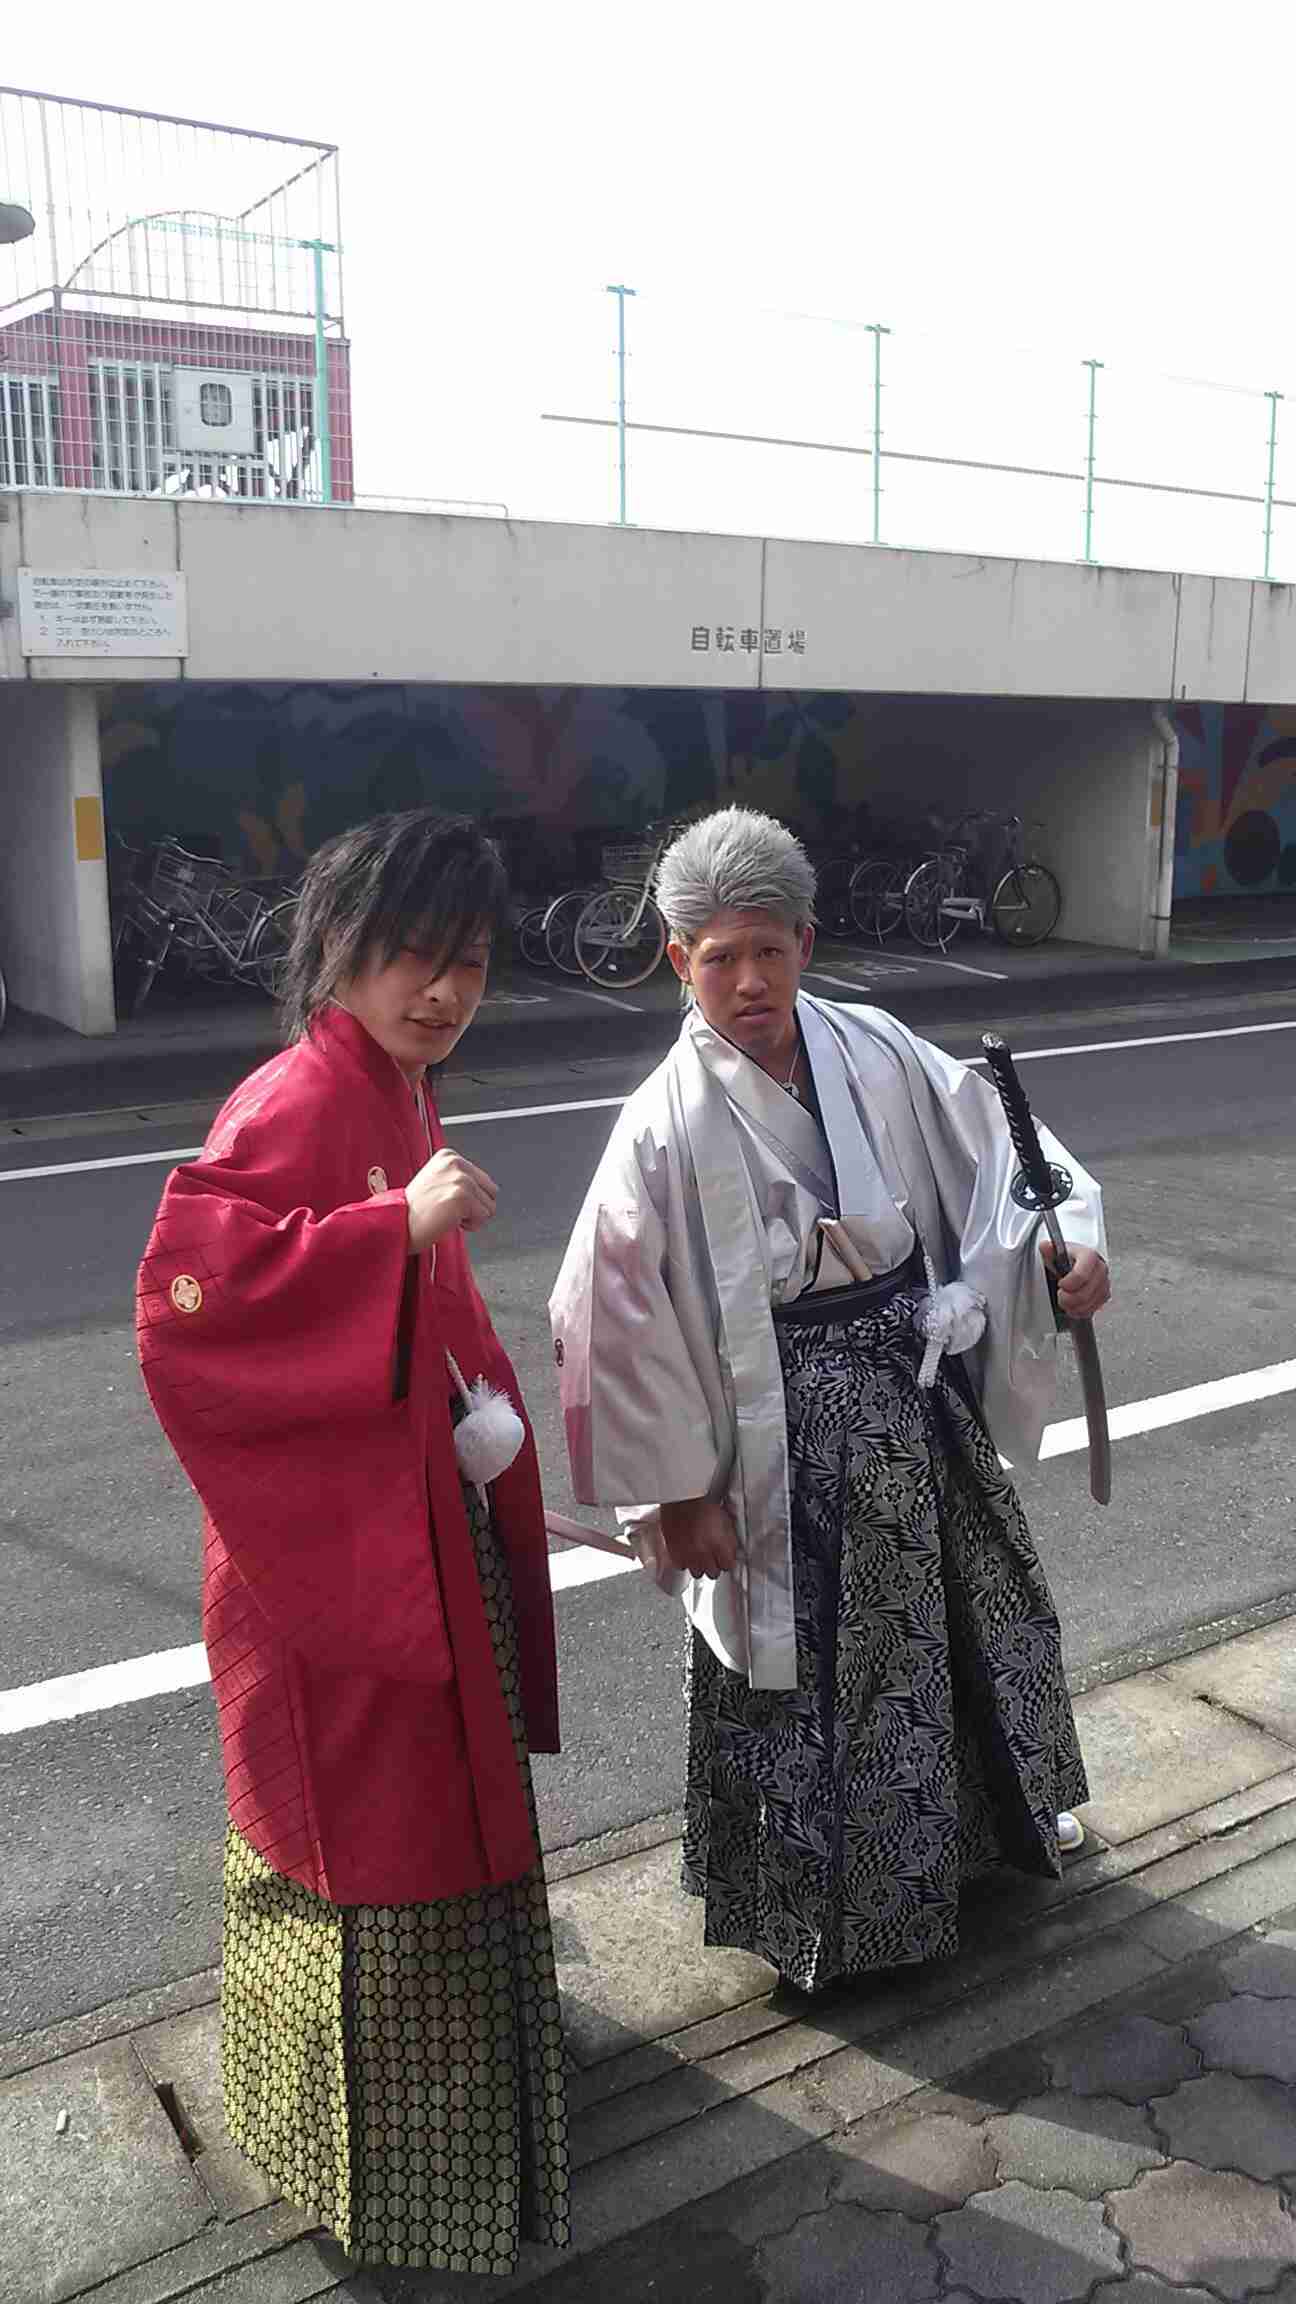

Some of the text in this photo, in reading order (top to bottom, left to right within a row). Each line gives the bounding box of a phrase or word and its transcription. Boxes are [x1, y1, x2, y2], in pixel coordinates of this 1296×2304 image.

[691, 626, 805, 655] 自転車置場
